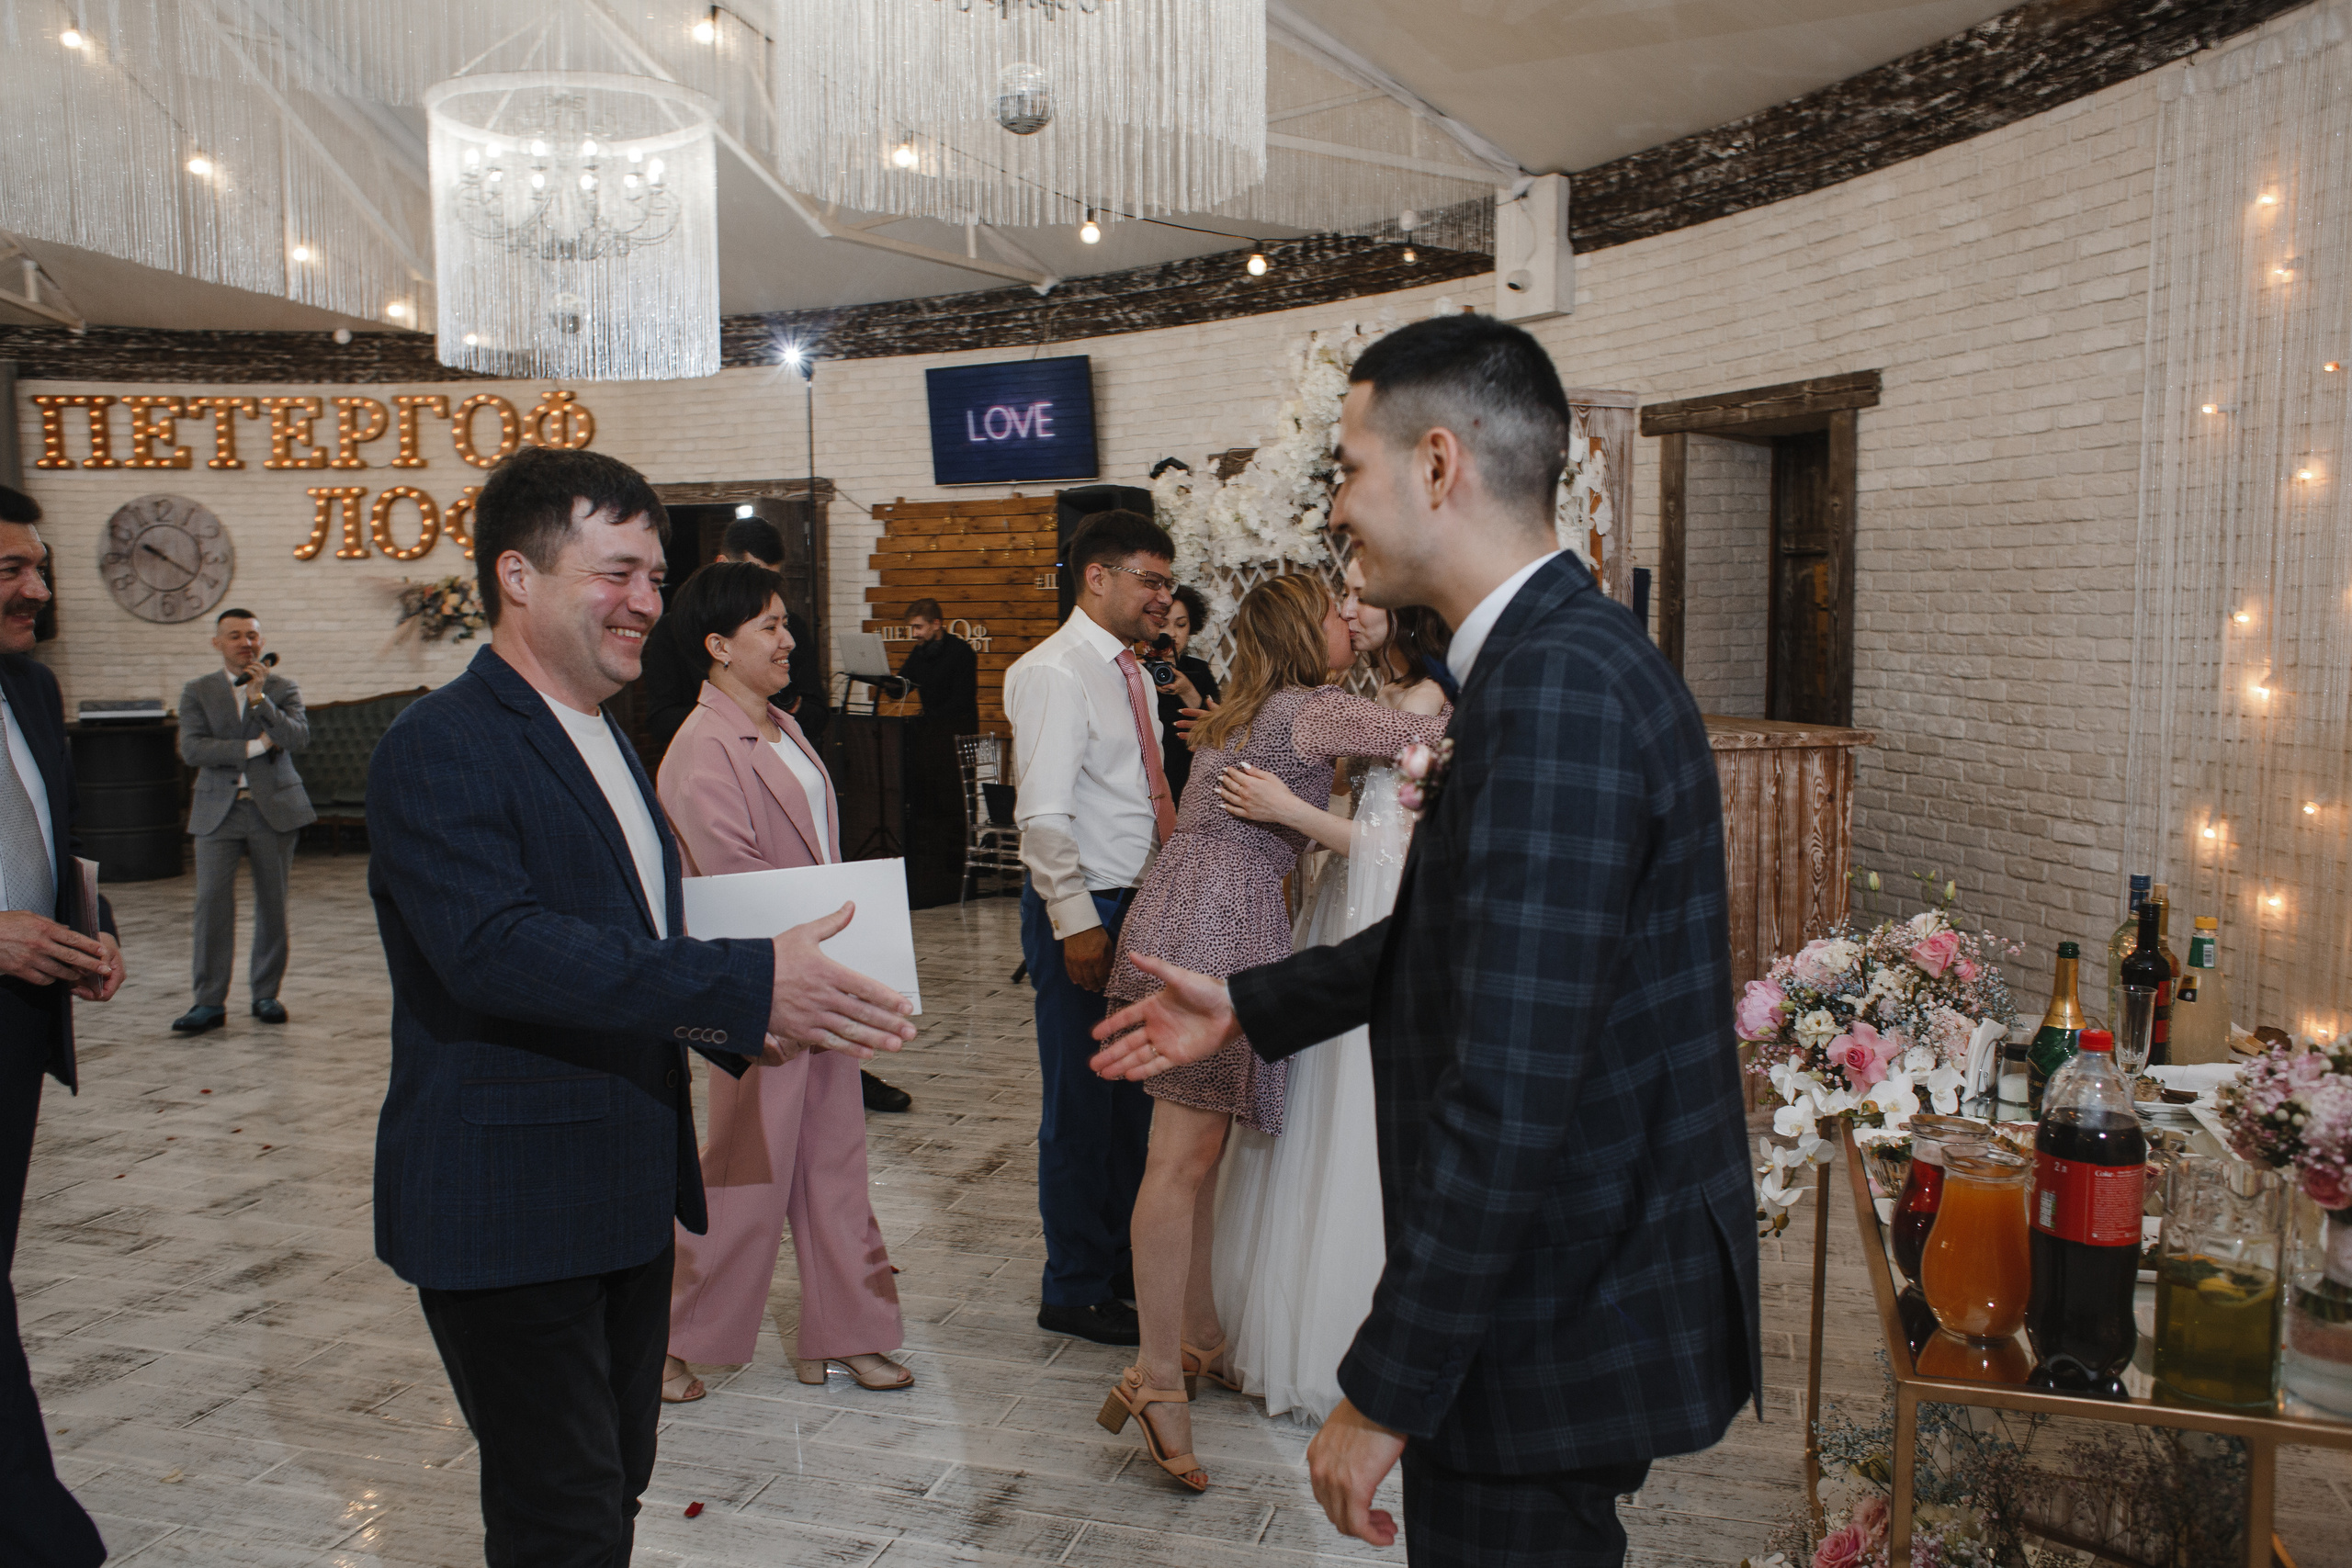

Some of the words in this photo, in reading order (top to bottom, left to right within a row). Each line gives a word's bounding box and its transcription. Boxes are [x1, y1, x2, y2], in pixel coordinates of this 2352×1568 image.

[32, 390, 594, 469] ПЕТЕРГОФ
[967, 401, 1056, 441] LOVE
[2054, 1161, 2060, 1171] 2
